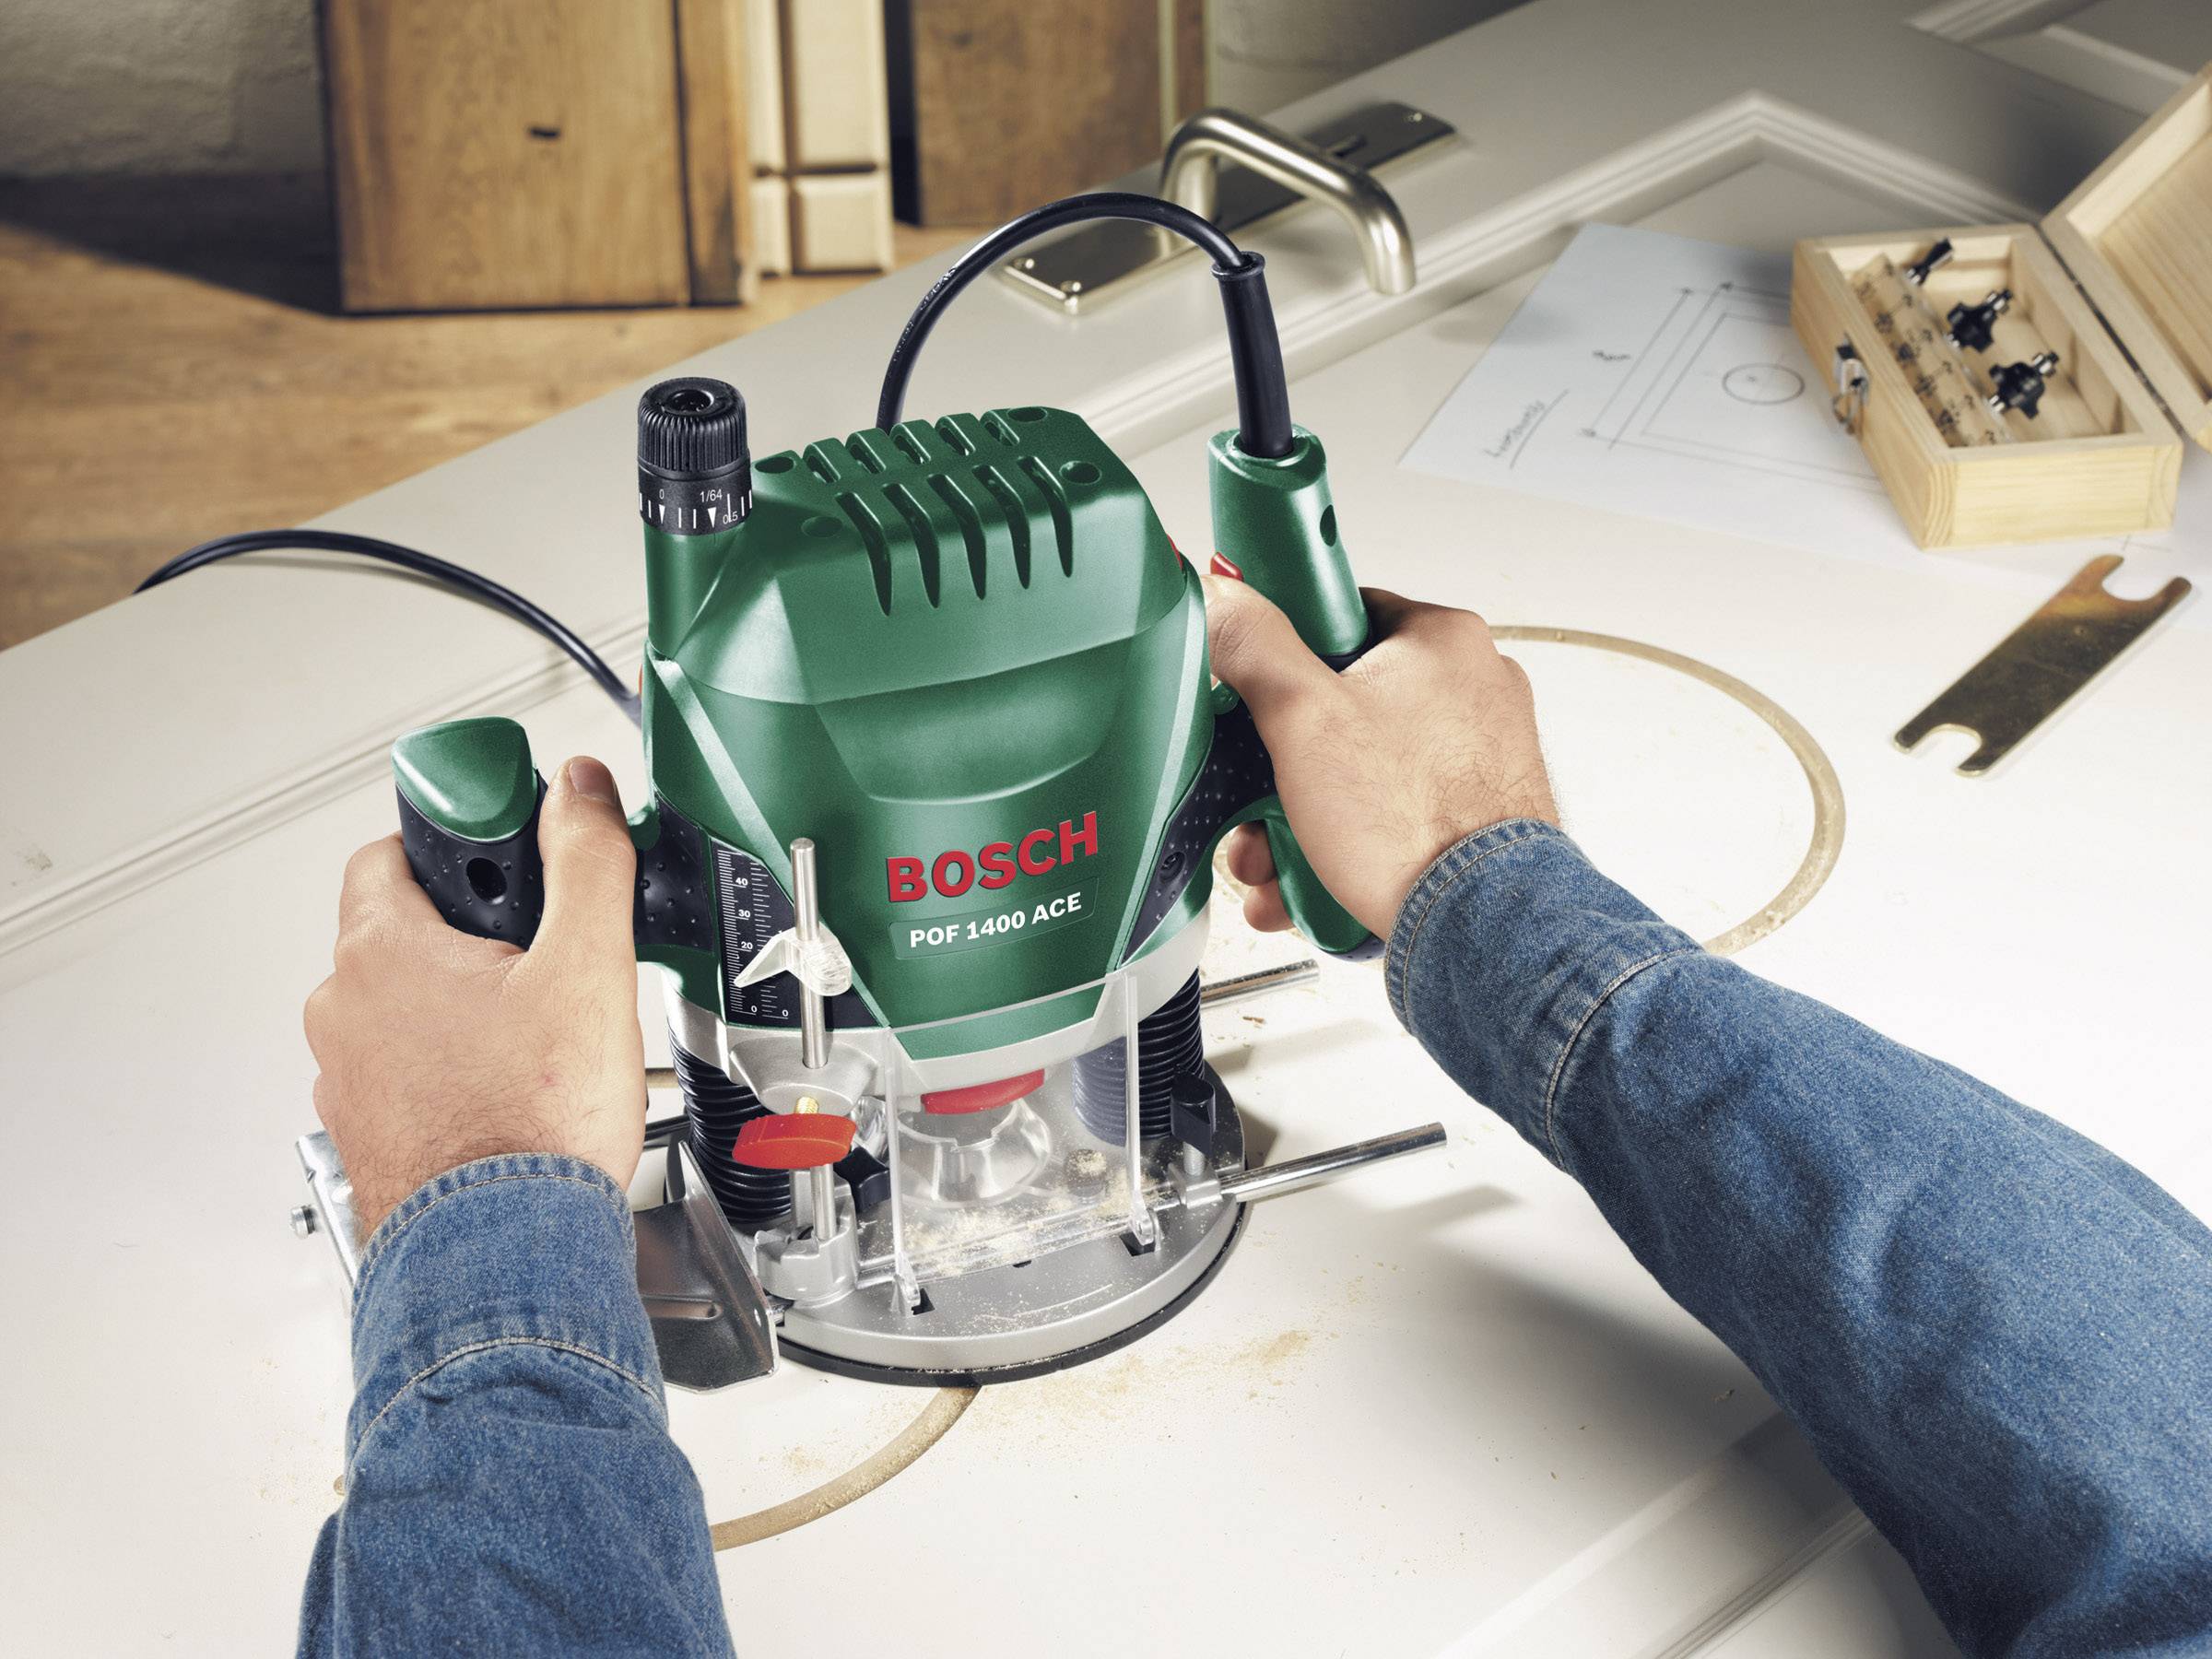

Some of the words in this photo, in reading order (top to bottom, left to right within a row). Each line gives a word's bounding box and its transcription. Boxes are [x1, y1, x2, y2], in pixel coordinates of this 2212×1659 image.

[659, 488, 665, 499] 0
[700, 488, 723, 502] 1/64
[886, 811, 1098, 902] BOSCH
[735, 877, 748, 887] 40
[738, 909, 750, 918] 30
[910, 924, 959, 947] POF
[966, 911, 1026, 940] 1400
[1031, 891, 1082, 924] ACE
[741, 941, 754, 950] 20
[750, 1005, 758, 1014] 0
[782, 1009, 789, 1018] 0
